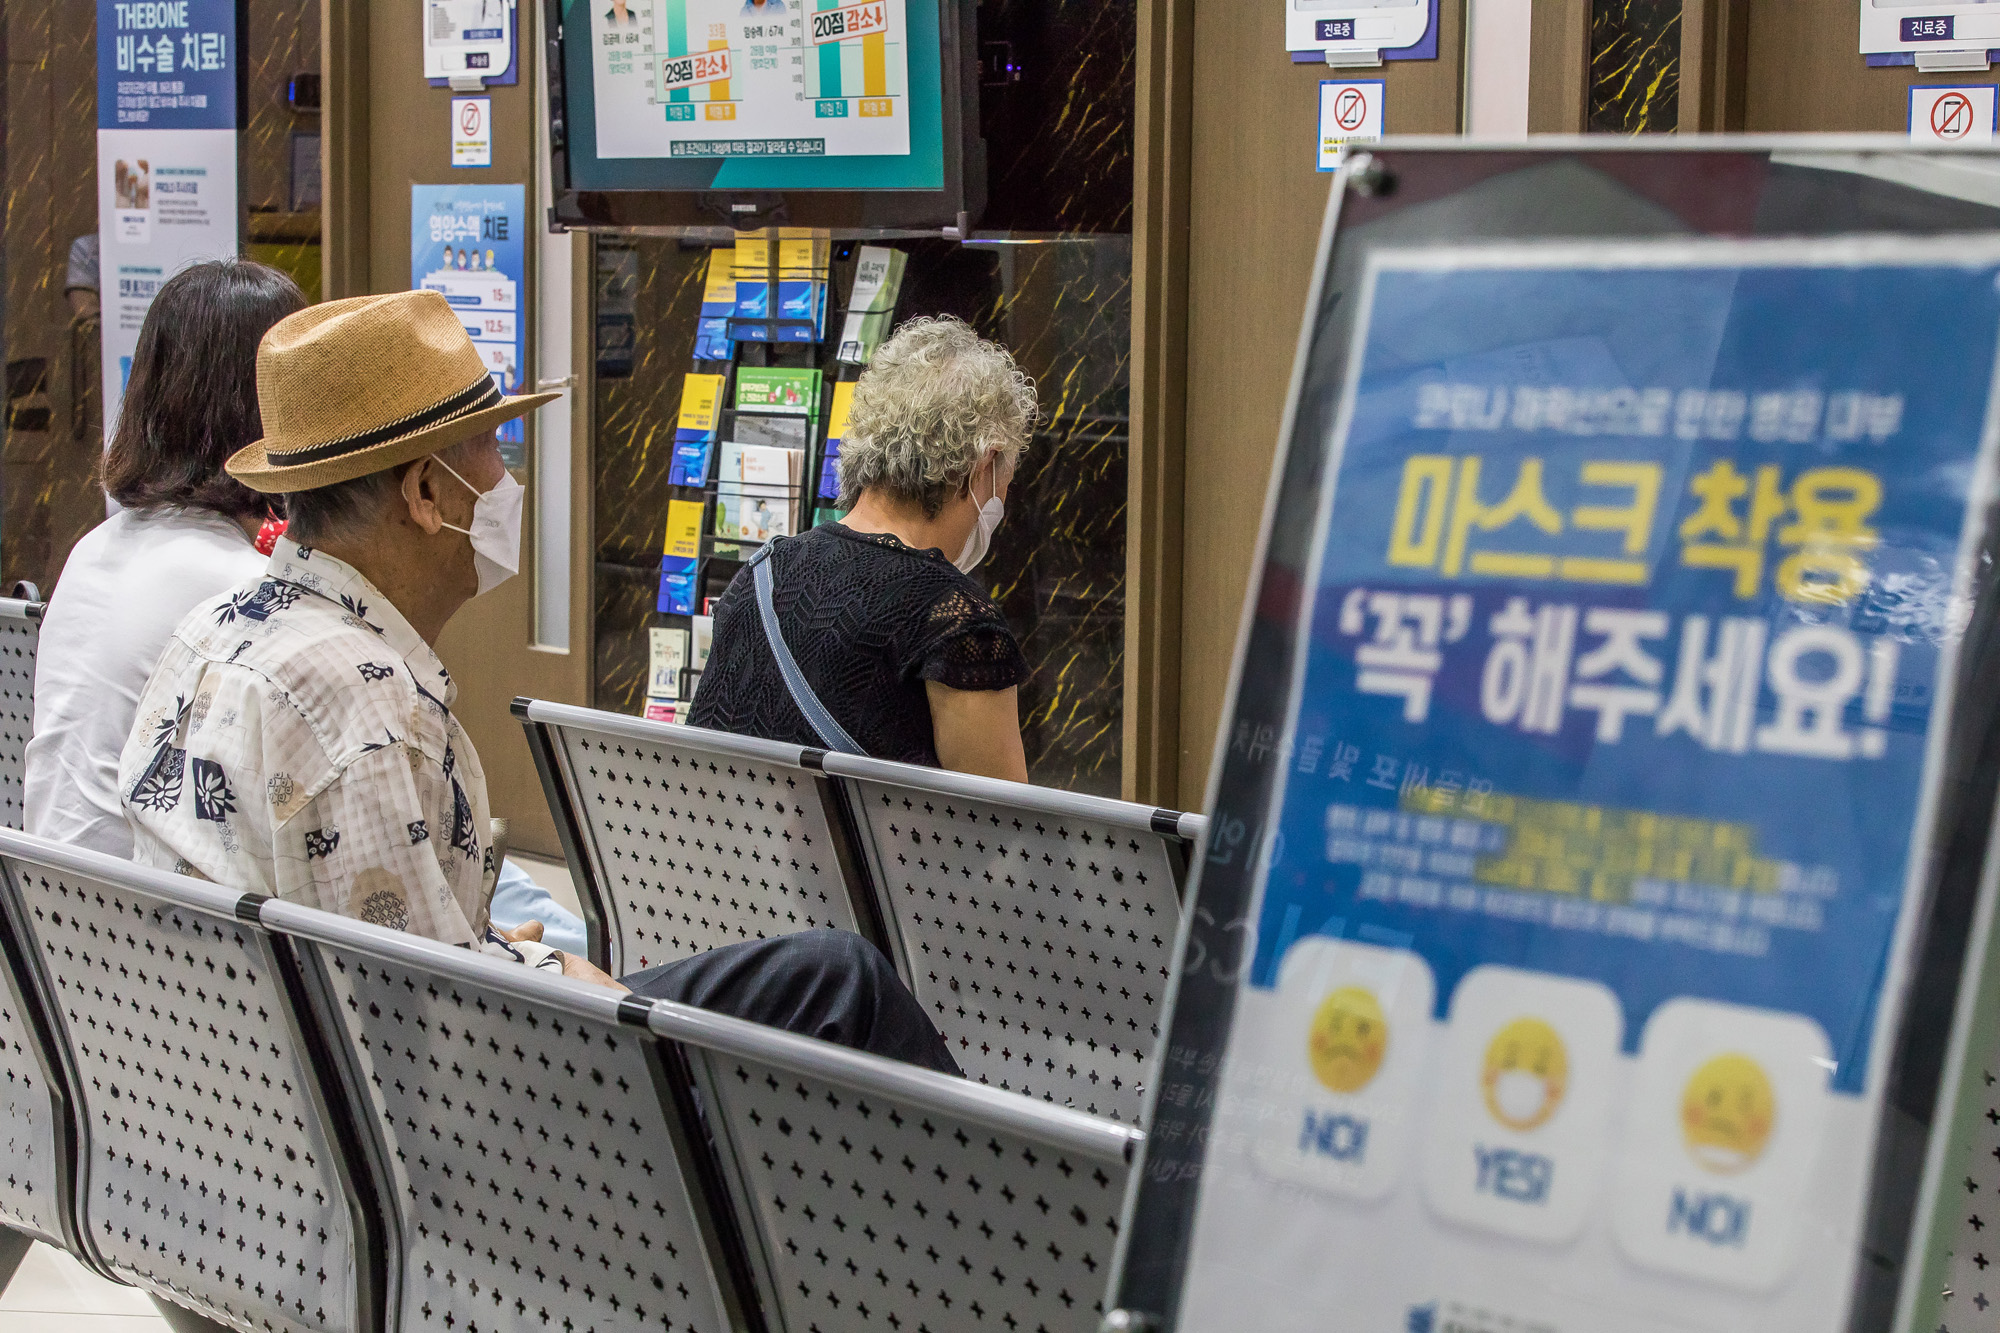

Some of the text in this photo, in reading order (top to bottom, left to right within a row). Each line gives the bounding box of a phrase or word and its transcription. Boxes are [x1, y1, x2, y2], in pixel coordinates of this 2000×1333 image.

[115, 1, 189, 30] THEBONE
[814, 6, 872, 37] 20점 감소
[1912, 20, 1947, 36] 진료중
[768, 25, 784, 37] 67세
[1324, 23, 1351, 37] 진료중
[116, 32, 226, 73] 비수술 치료!
[665, 57, 720, 83] 29점 감소
[788, 141, 795, 153] 수
[796, 141, 823, 154] 있습니다
[483, 216, 509, 241] 치료
[1386, 452, 1885, 605] 마스크 착용
[1480, 594, 1898, 760] 해주세요!
[1666, 1186, 1753, 1250] NO!
